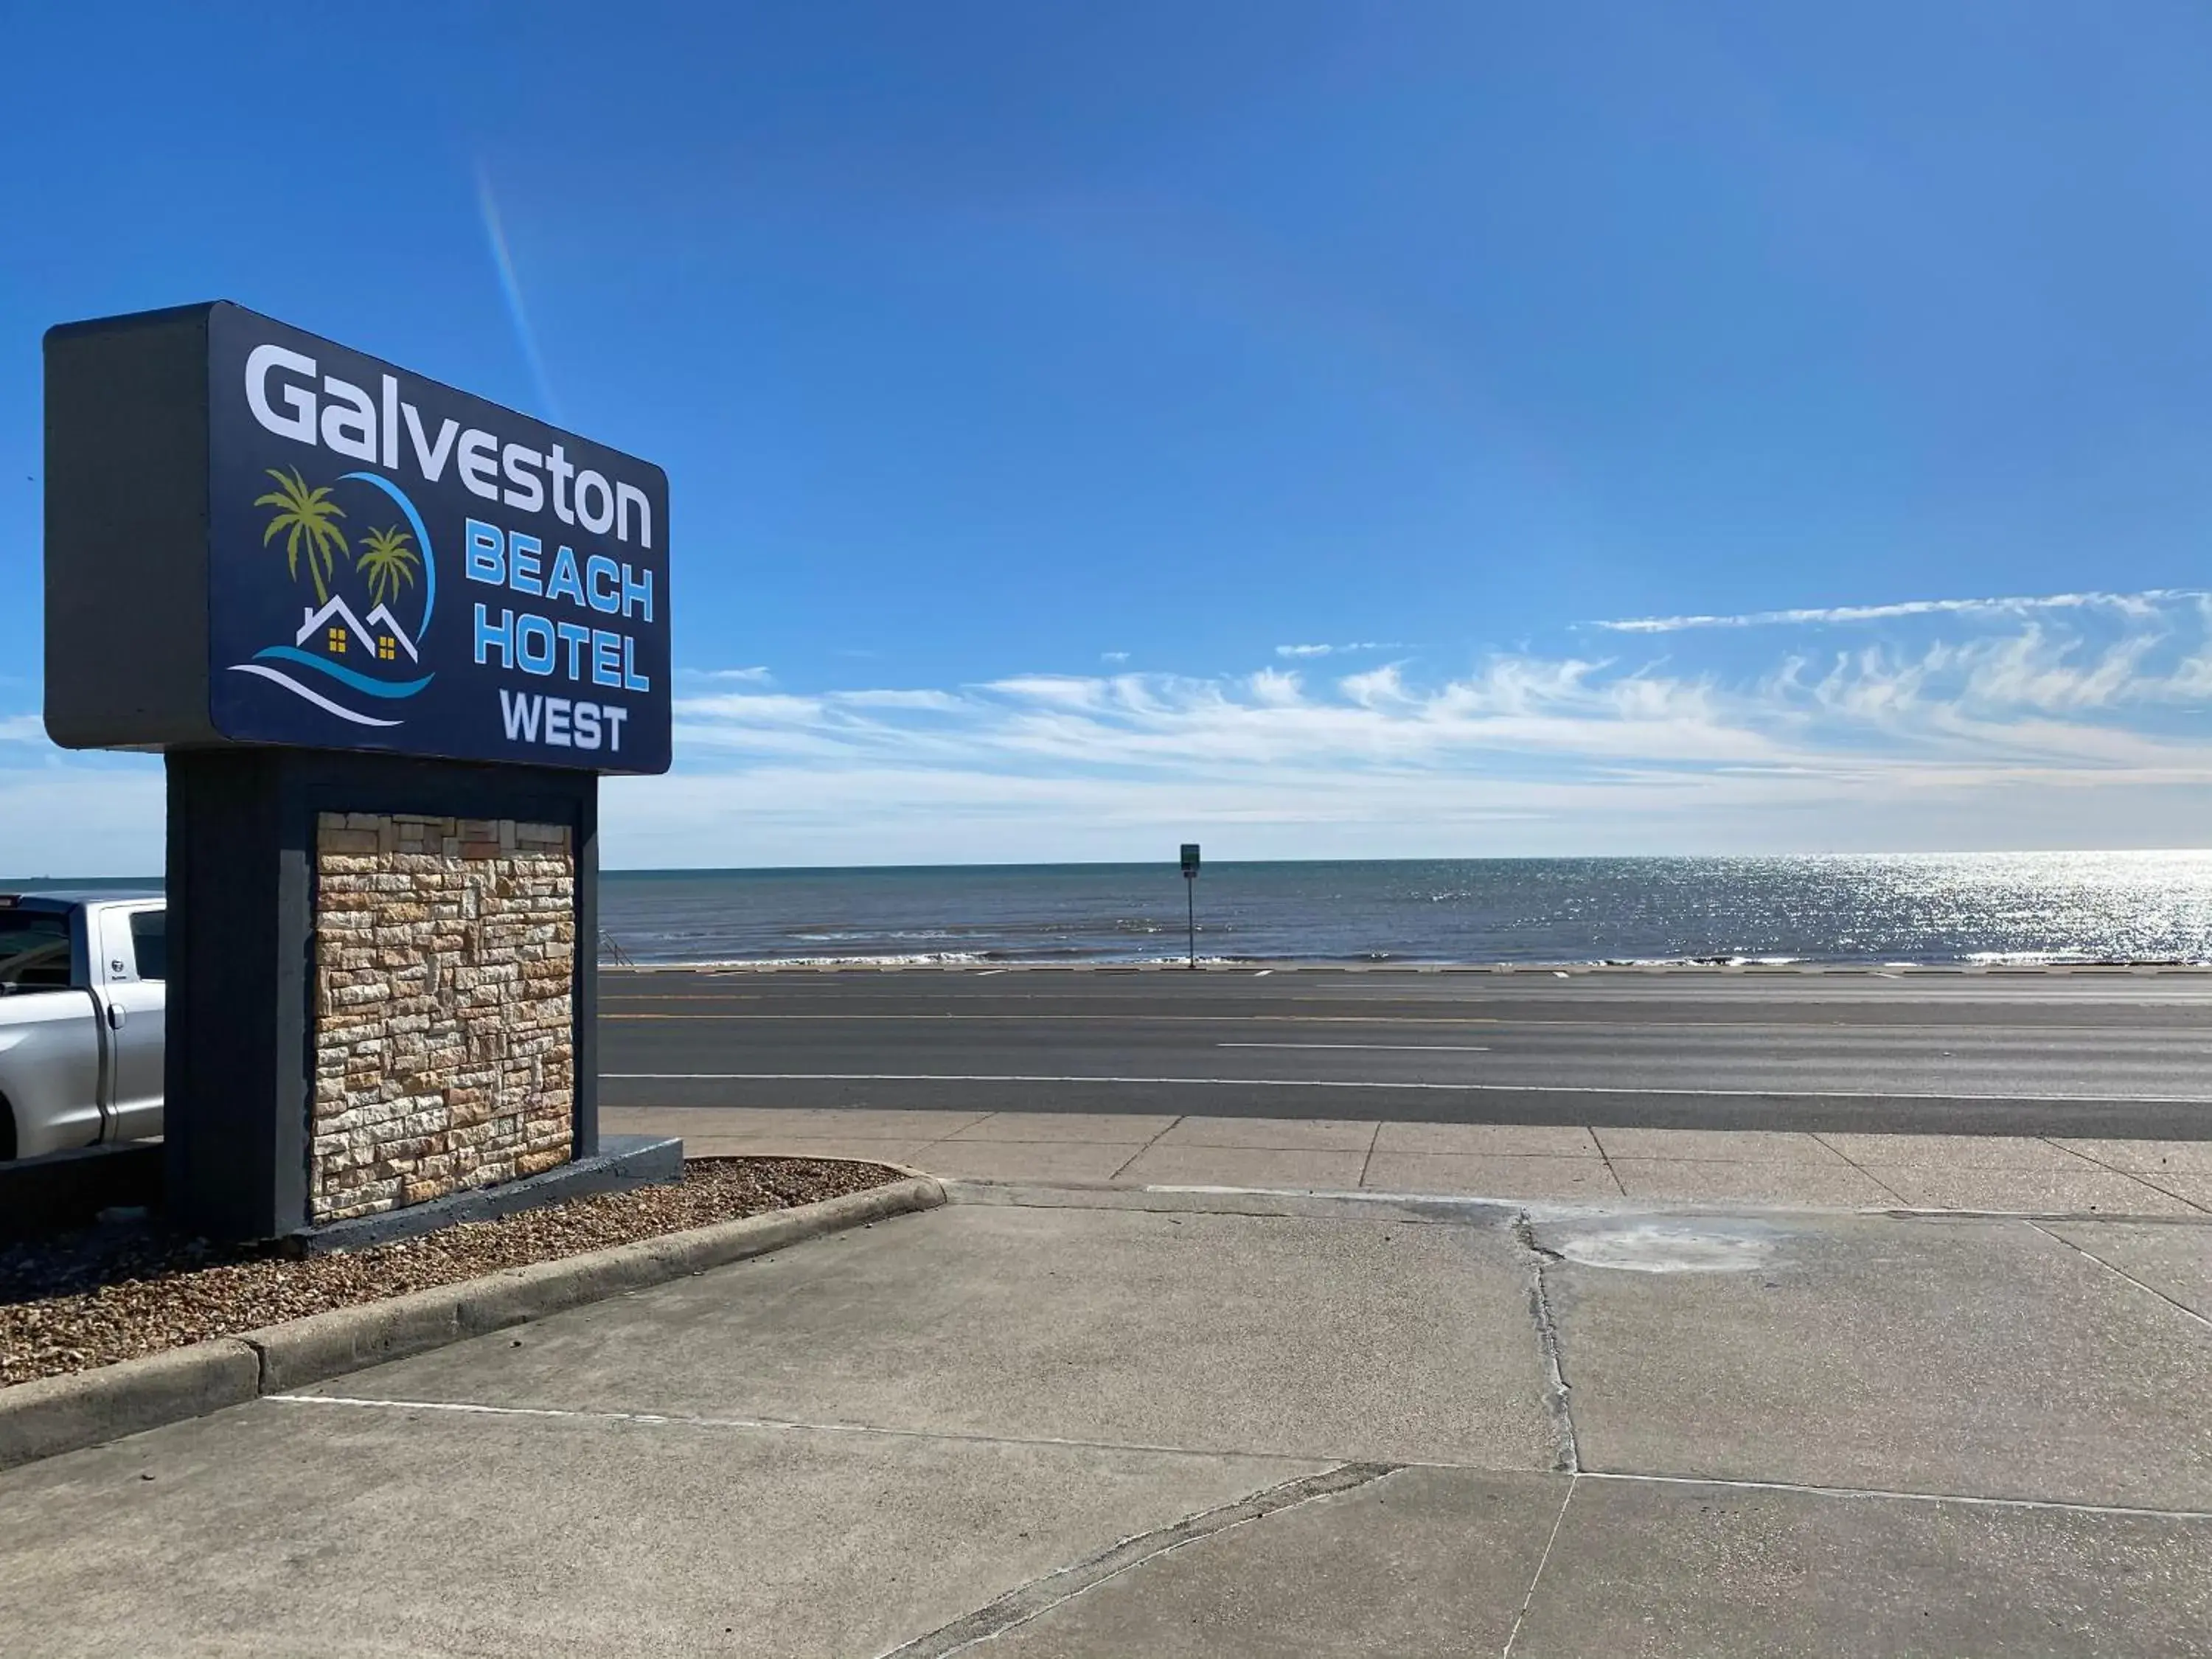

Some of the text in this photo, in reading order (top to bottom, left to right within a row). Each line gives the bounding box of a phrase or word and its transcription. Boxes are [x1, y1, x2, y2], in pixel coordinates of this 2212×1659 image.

[245, 344, 651, 548] Galveston
[465, 518, 653, 622] BEACH
[474, 603, 650, 692] HOTEL
[500, 689, 627, 751] WEST
